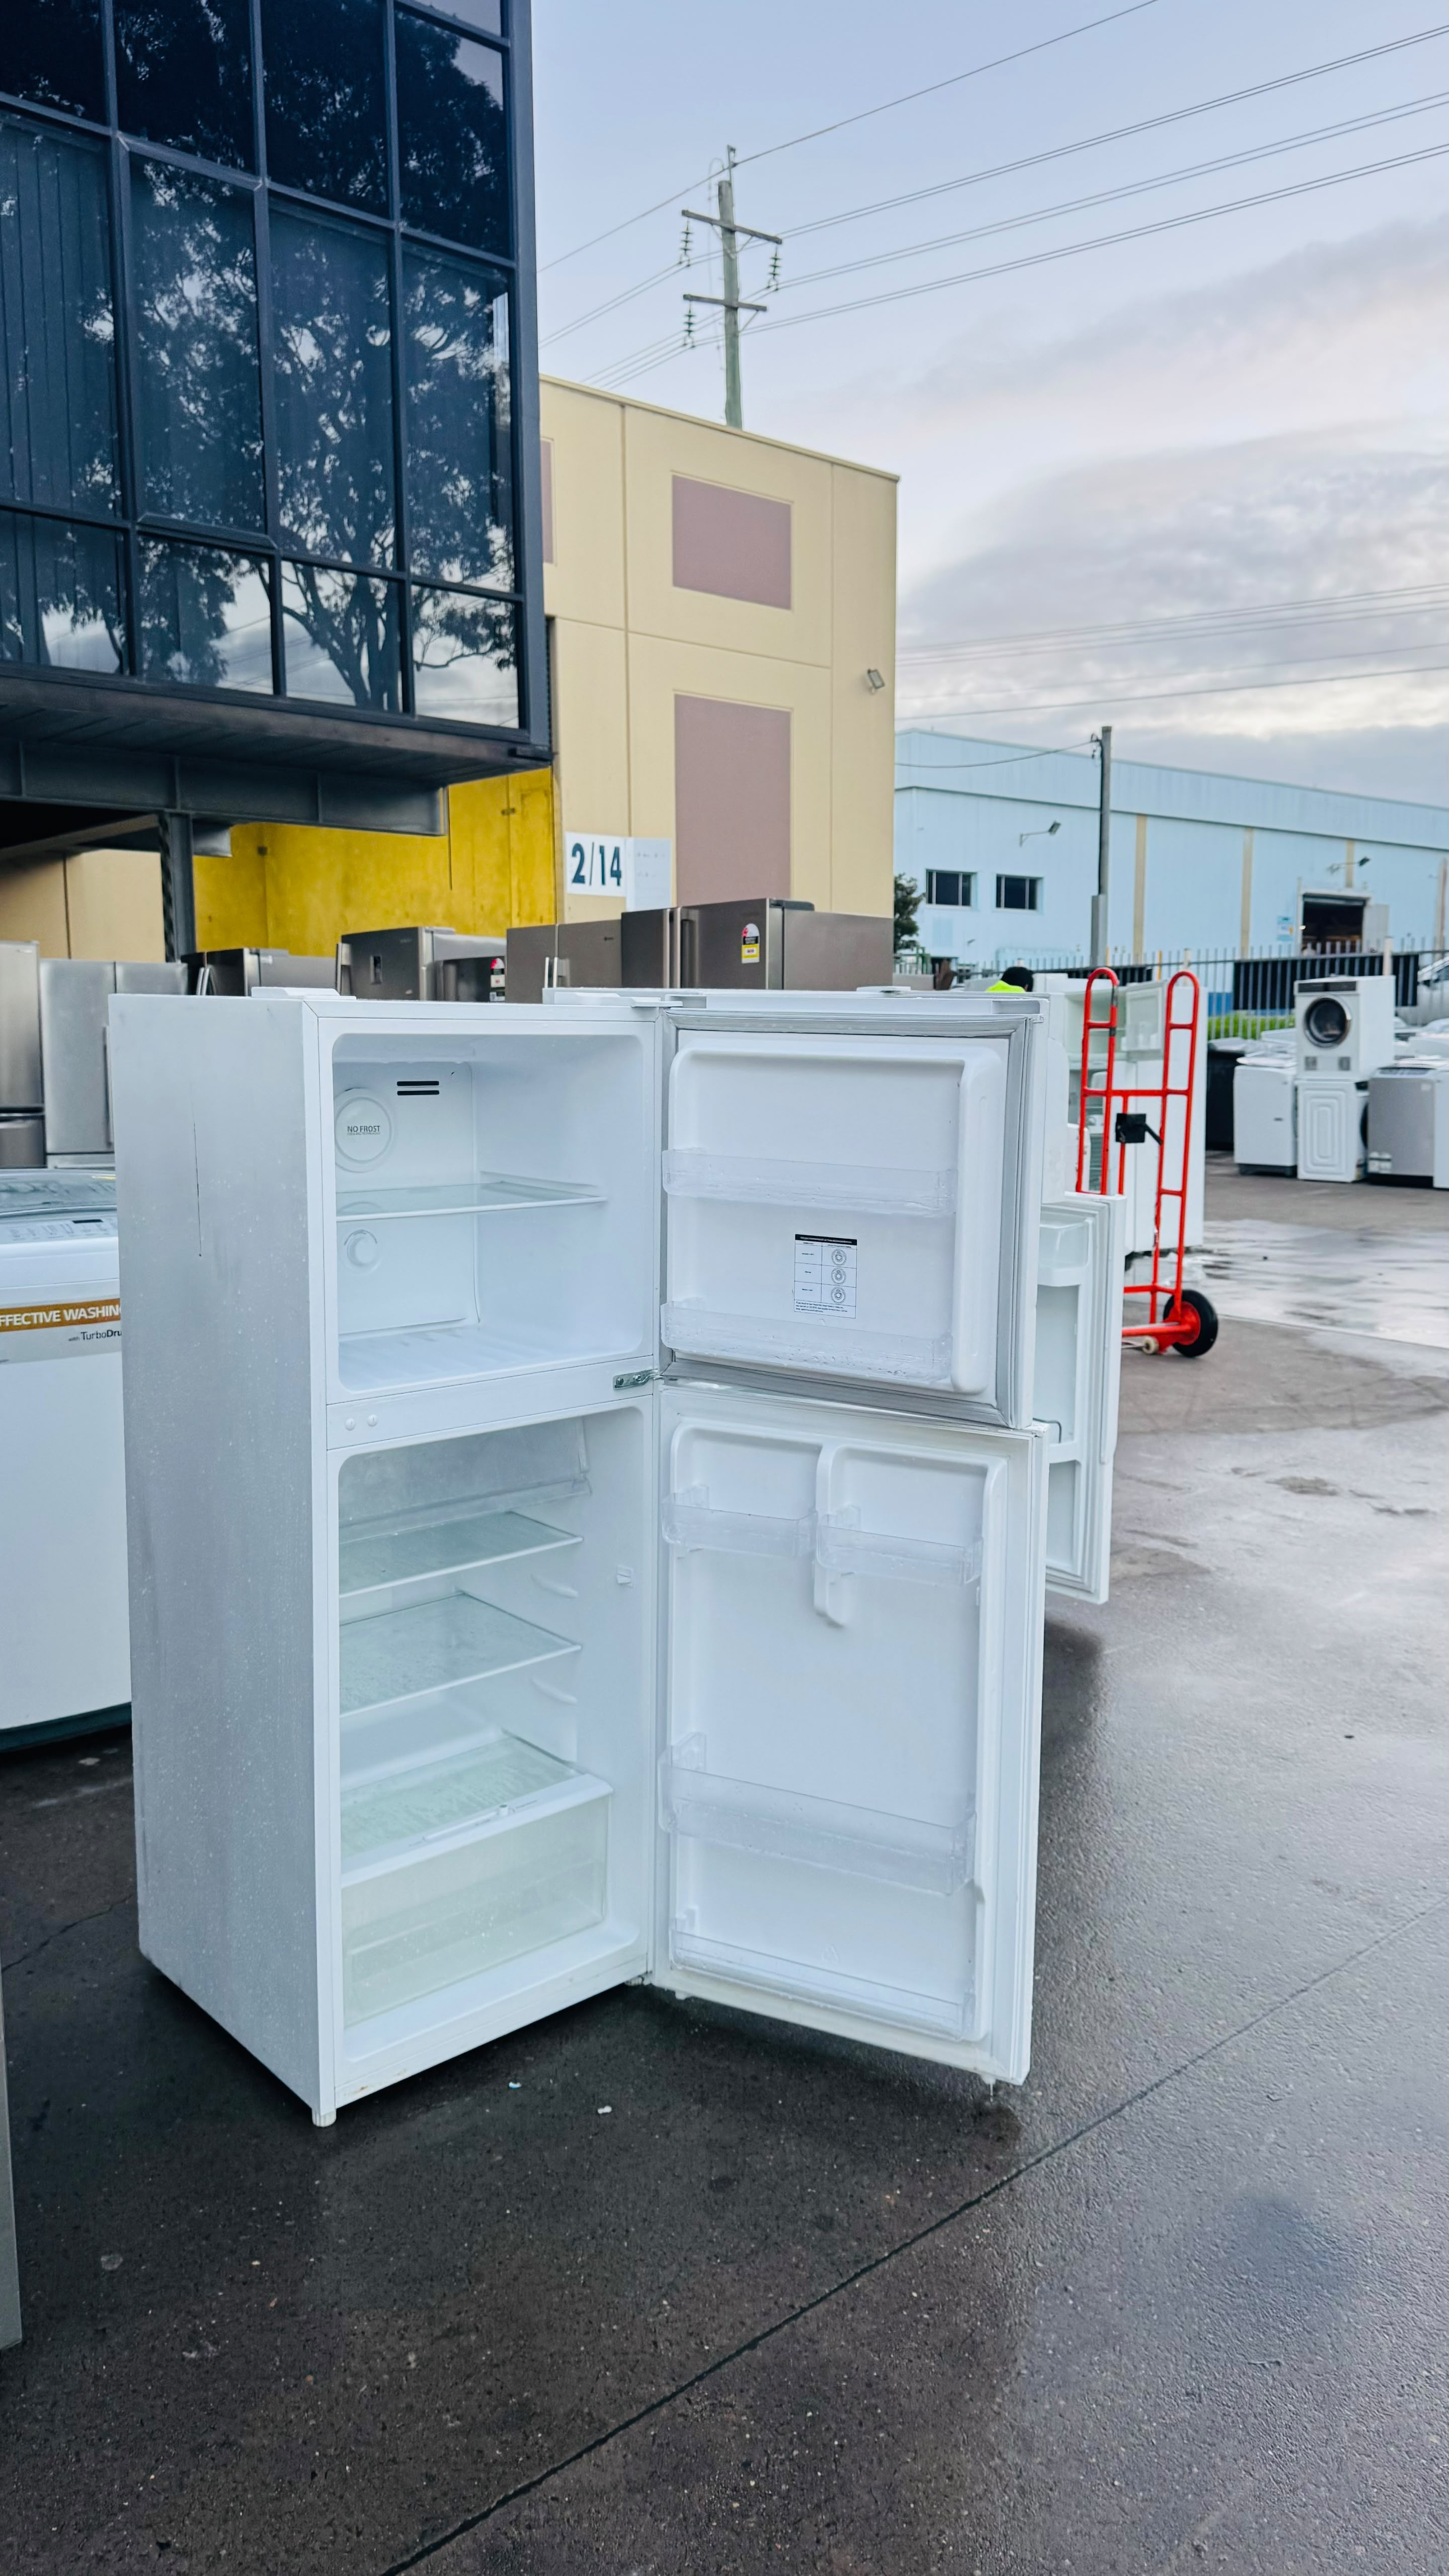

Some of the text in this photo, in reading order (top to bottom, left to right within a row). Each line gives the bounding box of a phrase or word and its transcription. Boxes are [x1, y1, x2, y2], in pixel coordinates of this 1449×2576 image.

[571, 842, 622, 887] 2/14
[0, 1304, 121, 1327] FFECTIVE WASHIN
